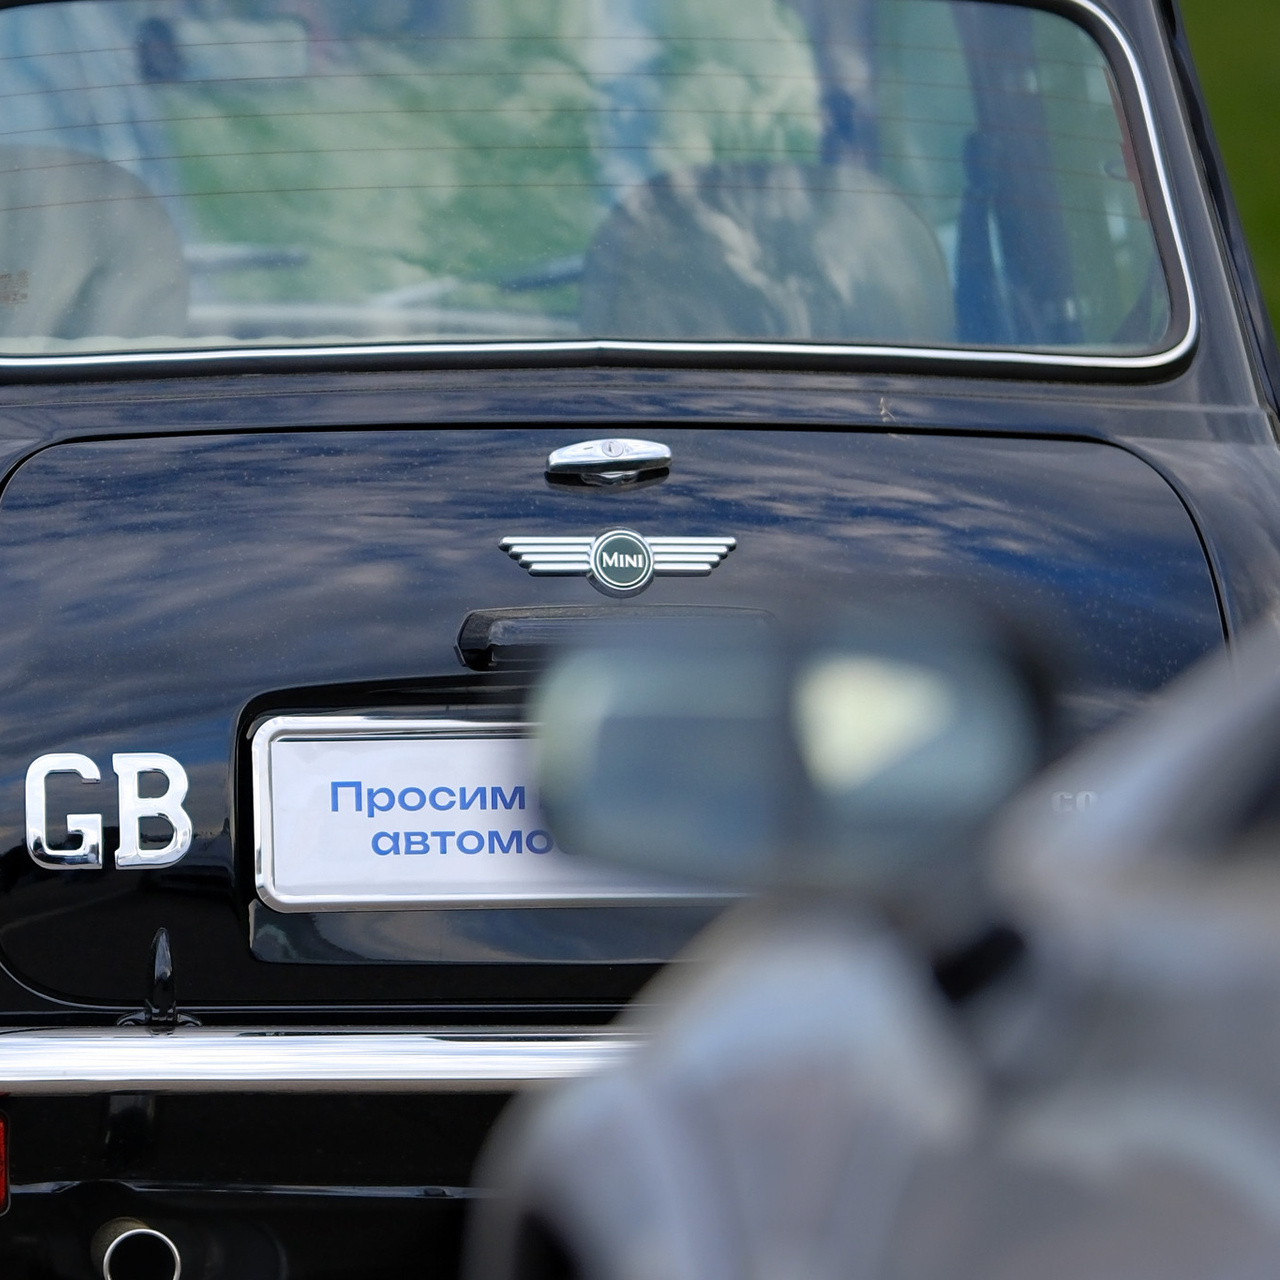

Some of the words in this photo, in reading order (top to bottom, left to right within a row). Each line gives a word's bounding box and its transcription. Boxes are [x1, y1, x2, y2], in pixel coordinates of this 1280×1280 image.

[601, 551, 643, 568] MINI
[25, 752, 193, 869] GB
[330, 780, 526, 818] Просим
